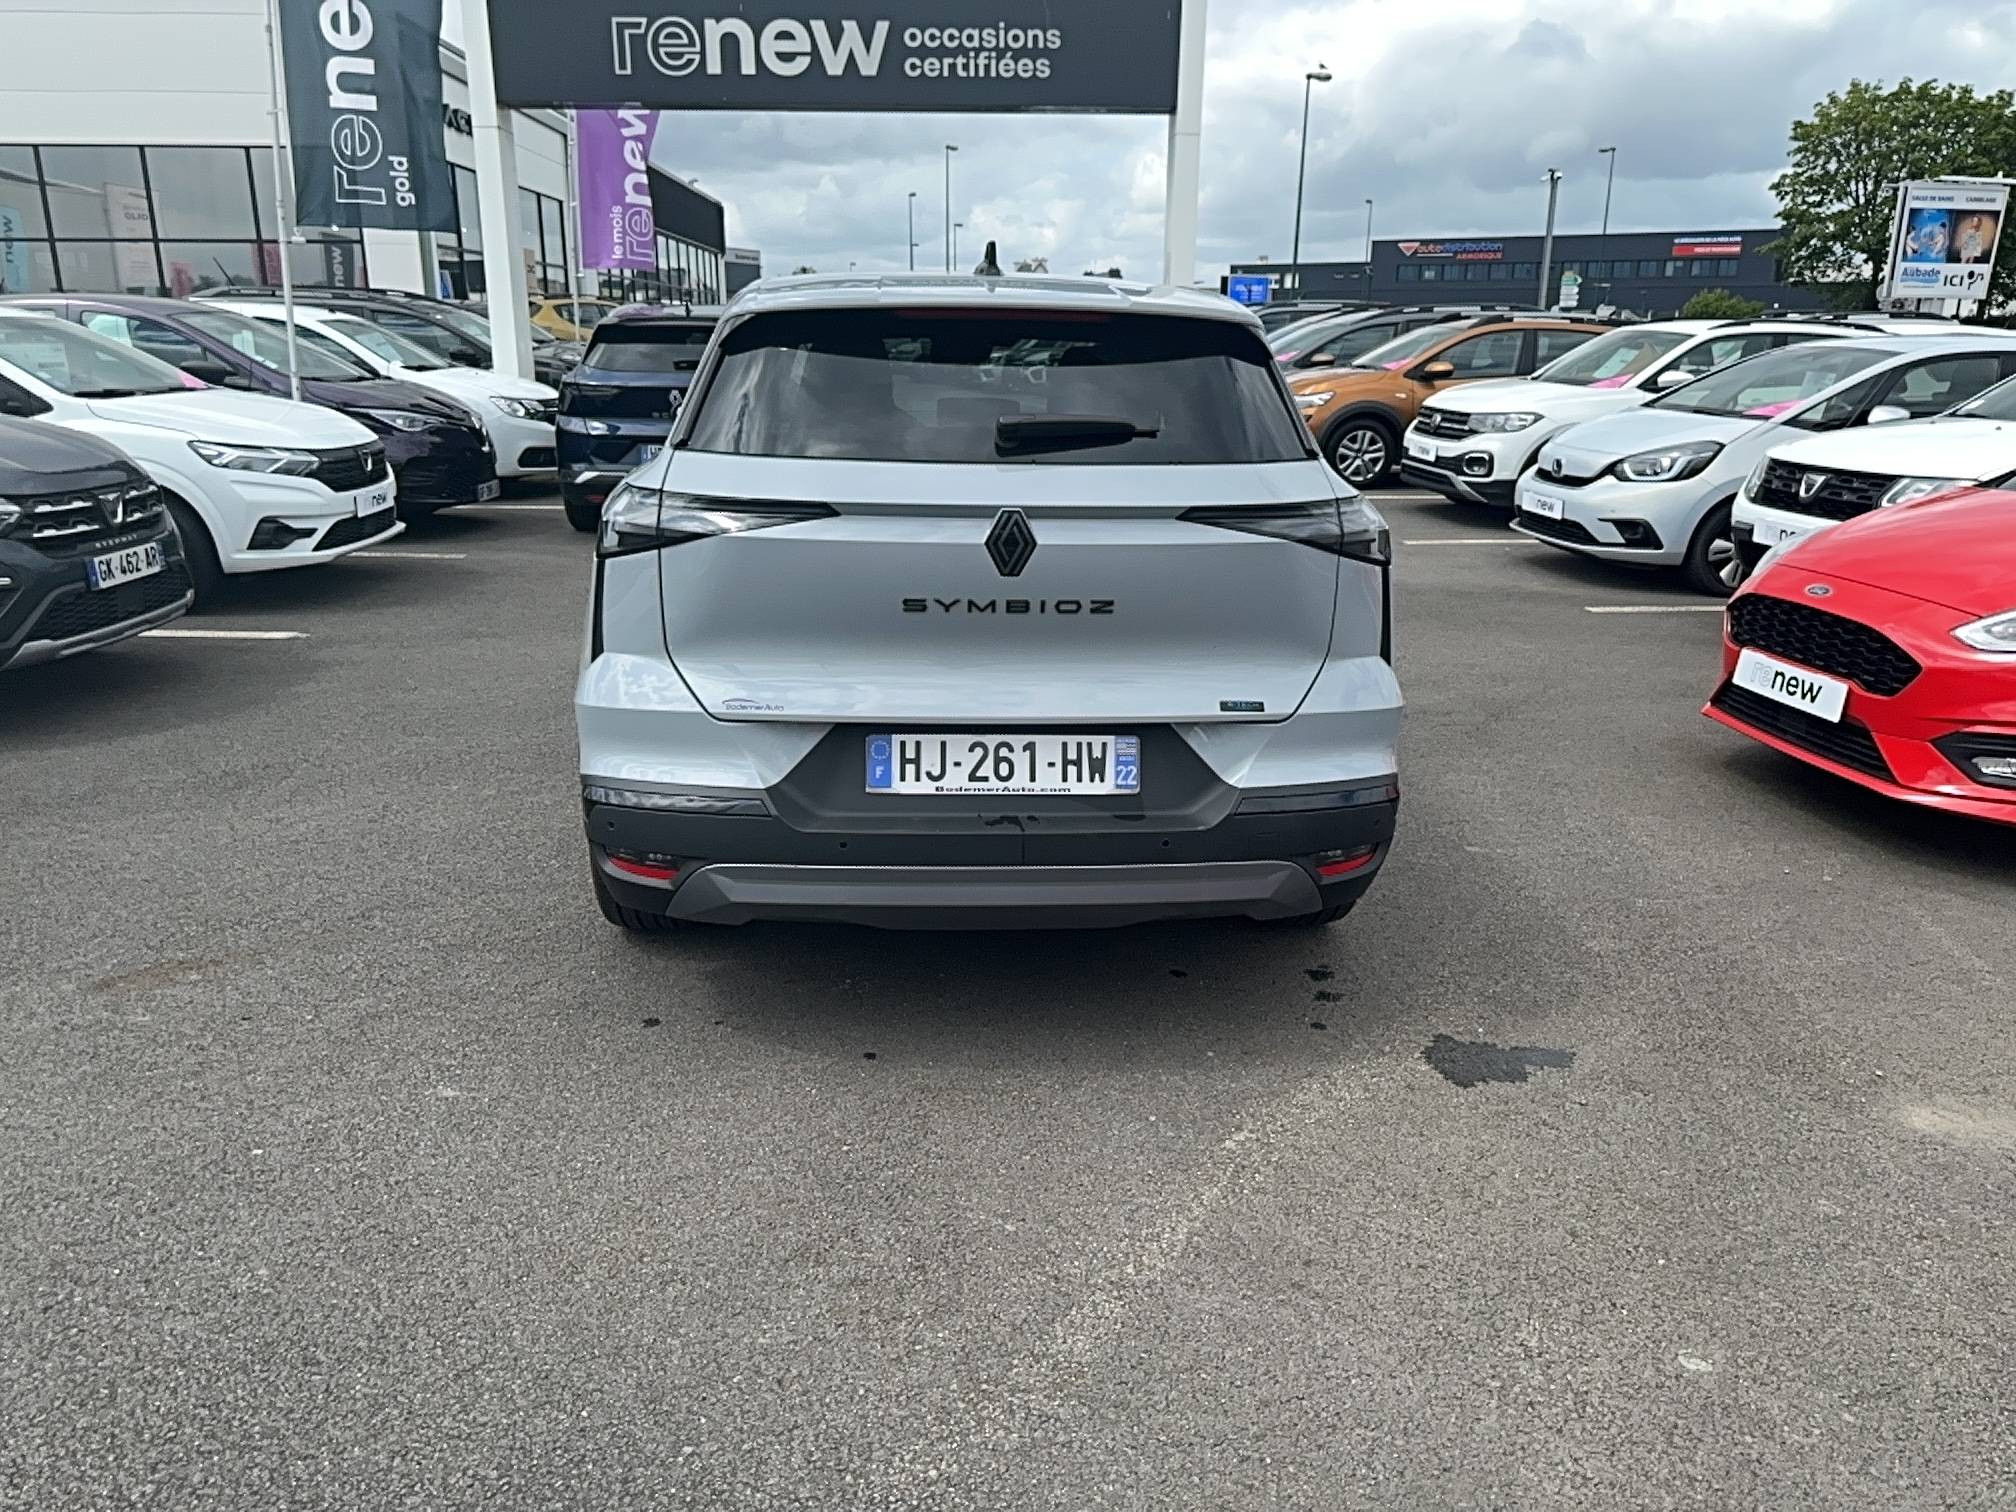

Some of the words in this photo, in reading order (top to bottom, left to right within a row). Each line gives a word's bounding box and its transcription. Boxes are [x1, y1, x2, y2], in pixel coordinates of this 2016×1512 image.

[611, 16, 890, 77] renew
[903, 22, 1062, 49] occasions
[903, 51, 1051, 78] certifiées
[388, 155, 416, 207] gold
[609, 205, 624, 244] mois
[611, 245, 624, 260] le
[1943, 274, 1965, 287] ICI
[97, 546, 160, 582] GK-462-AR
[902, 598, 1115, 614] SYMBIOZ
[875, 766, 884, 779] F
[899, 740, 1108, 783] HJ-261-HW
[1116, 765, 1137, 785] 22
